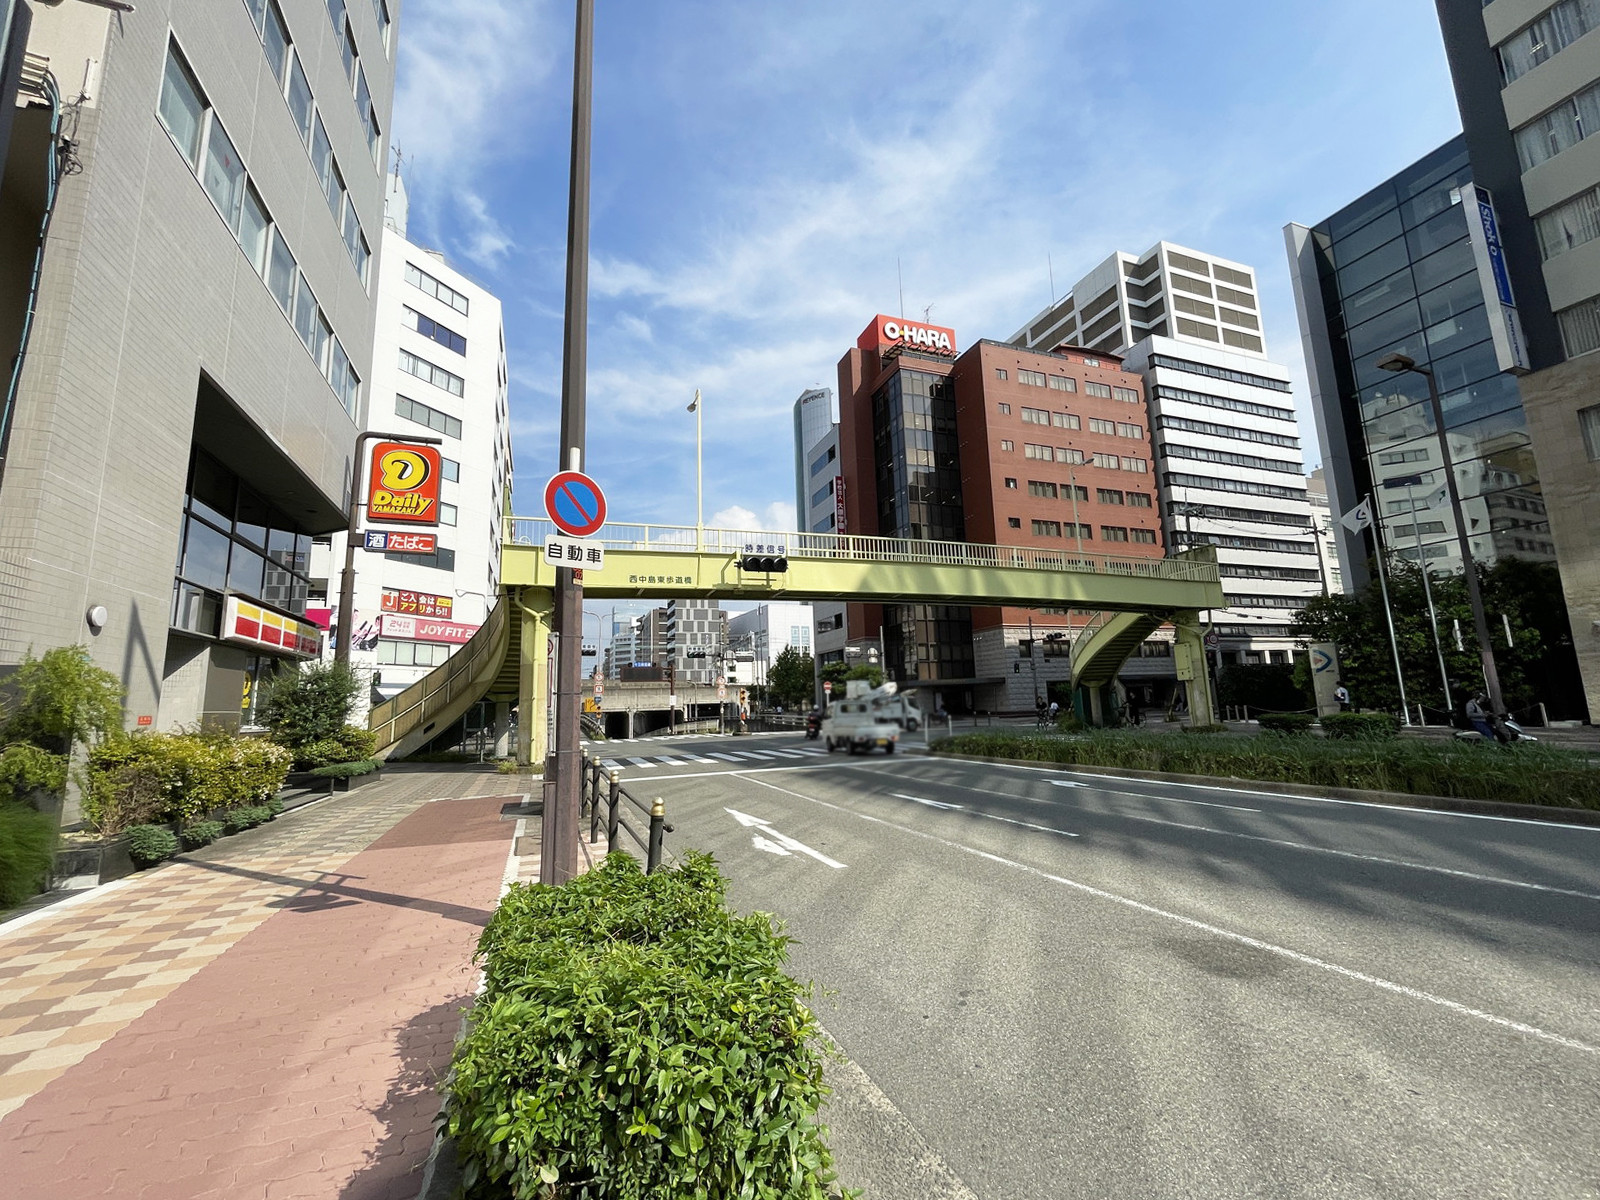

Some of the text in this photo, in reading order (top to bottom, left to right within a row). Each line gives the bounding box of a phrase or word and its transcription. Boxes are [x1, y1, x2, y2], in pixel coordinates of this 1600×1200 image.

[373, 490, 434, 515] Daily
[373, 505, 416, 514] YAMAZAKI
[368, 533, 433, 550] 酒 たばこ
[548, 542, 601, 563] 自動車
[745, 544, 785, 554] 時差信号
[629, 575, 692, 584] 西中島東歩道橋
[400, 592, 435, 605] ご入会は
